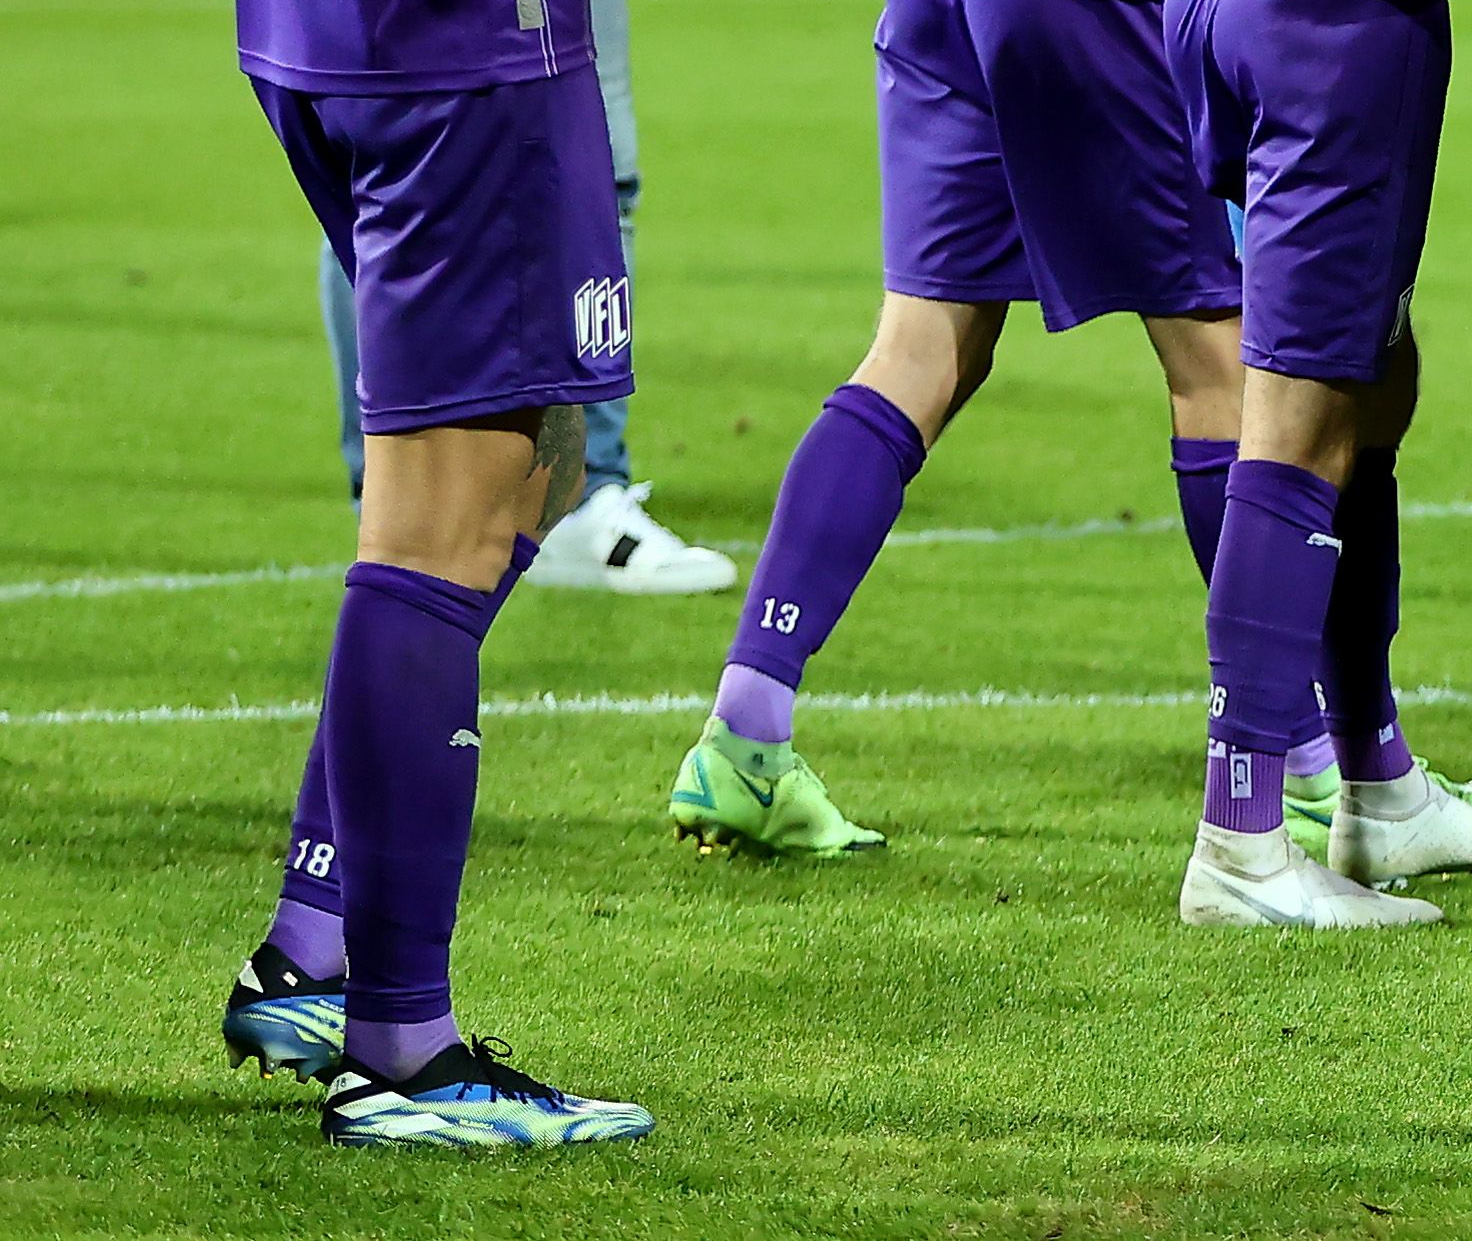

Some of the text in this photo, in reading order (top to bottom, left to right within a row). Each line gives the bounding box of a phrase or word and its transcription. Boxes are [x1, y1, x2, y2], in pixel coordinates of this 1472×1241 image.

[576, 279, 629, 355] VFL
[760, 597, 800, 634] 13
[293, 838, 336, 878] 18
